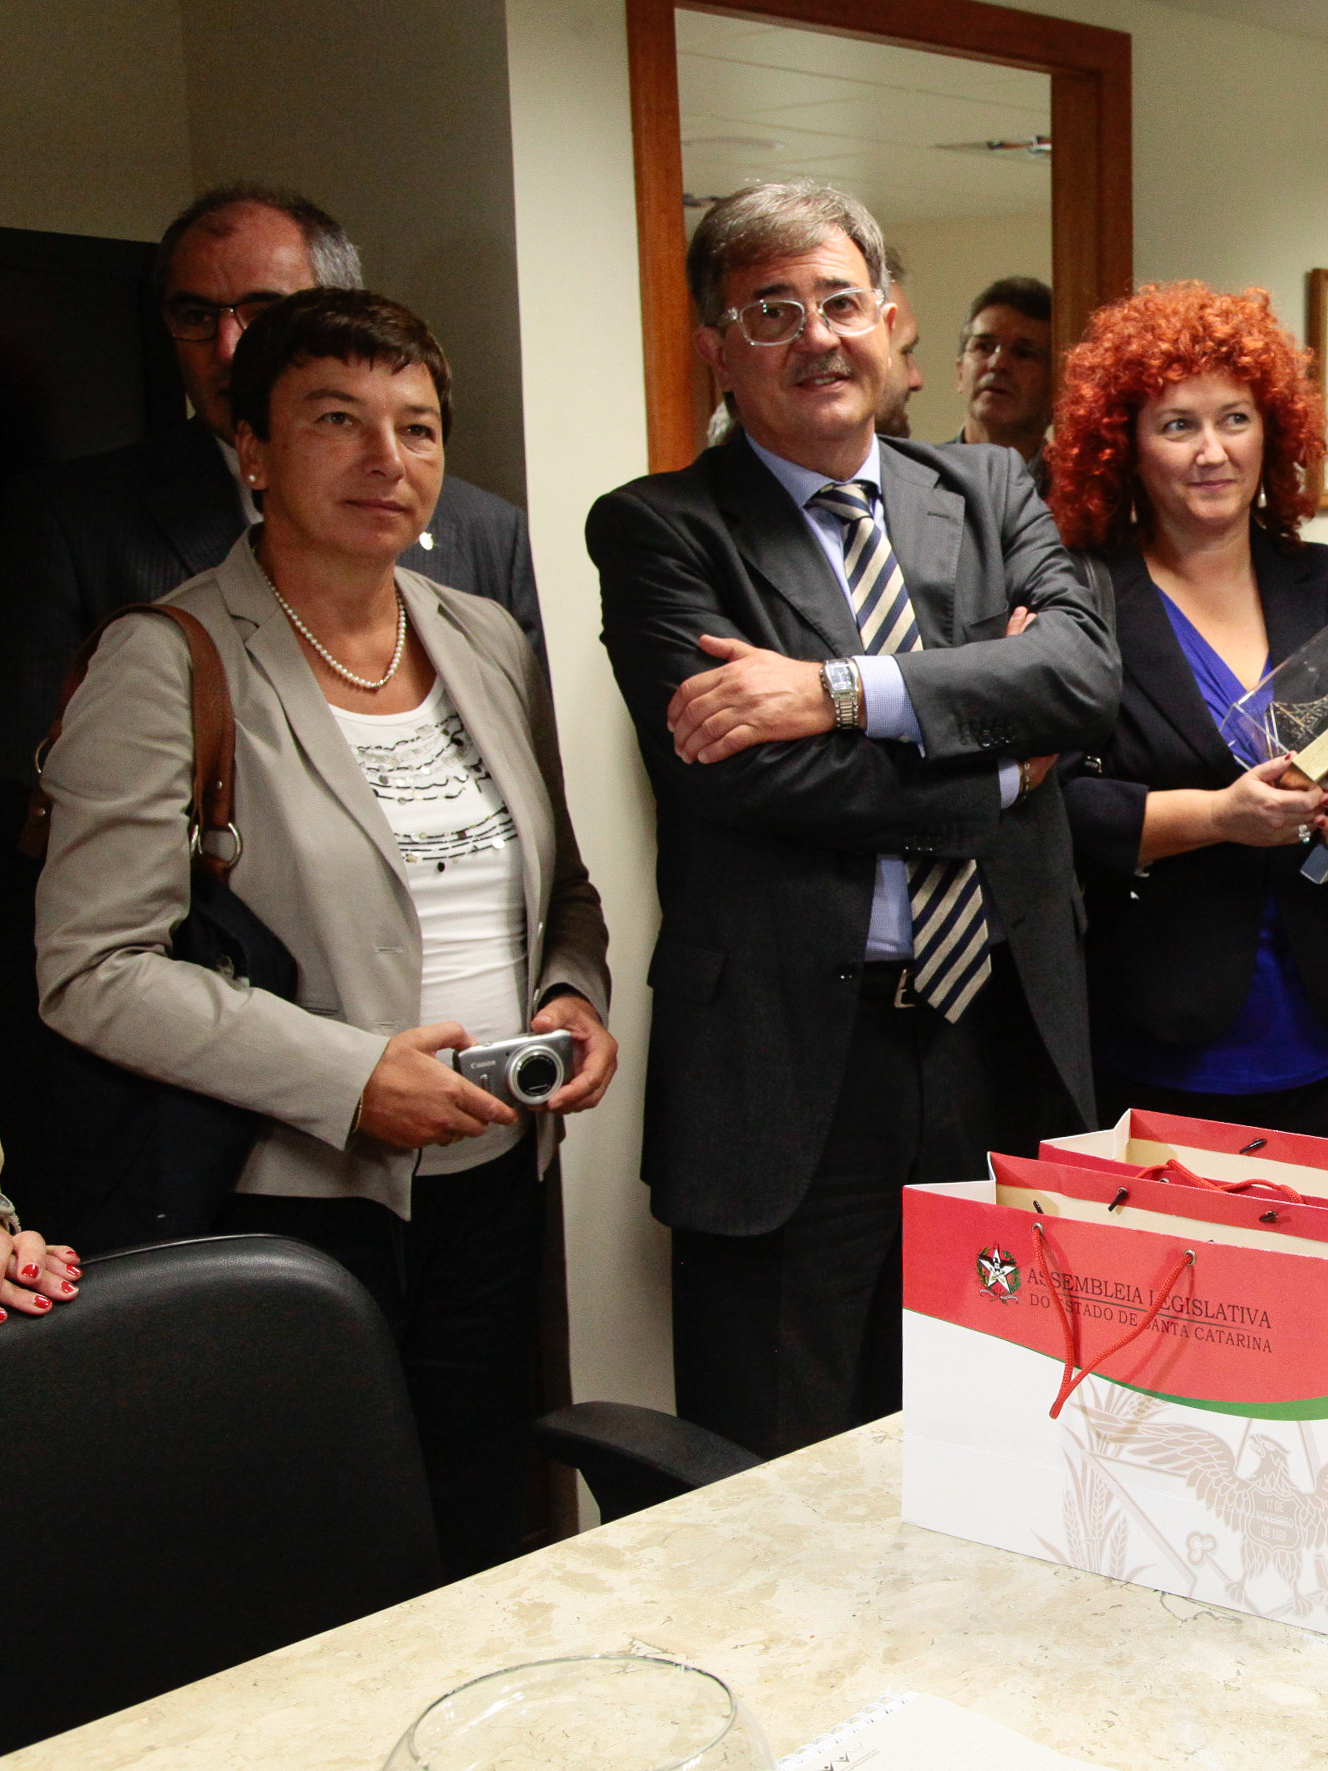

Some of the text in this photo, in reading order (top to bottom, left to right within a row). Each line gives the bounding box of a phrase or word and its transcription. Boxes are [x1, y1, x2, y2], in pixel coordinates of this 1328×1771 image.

[470, 1060, 496, 1069] Canon
[1030, 1293, 1050, 1309] DO
[1058, 1298, 1114, 1321] STADO
[1119, 1310, 1138, 1326] DE
[1194, 1327, 1271, 1352] CATARINA
[1266, 1497, 1284, 1512] 17 DE
